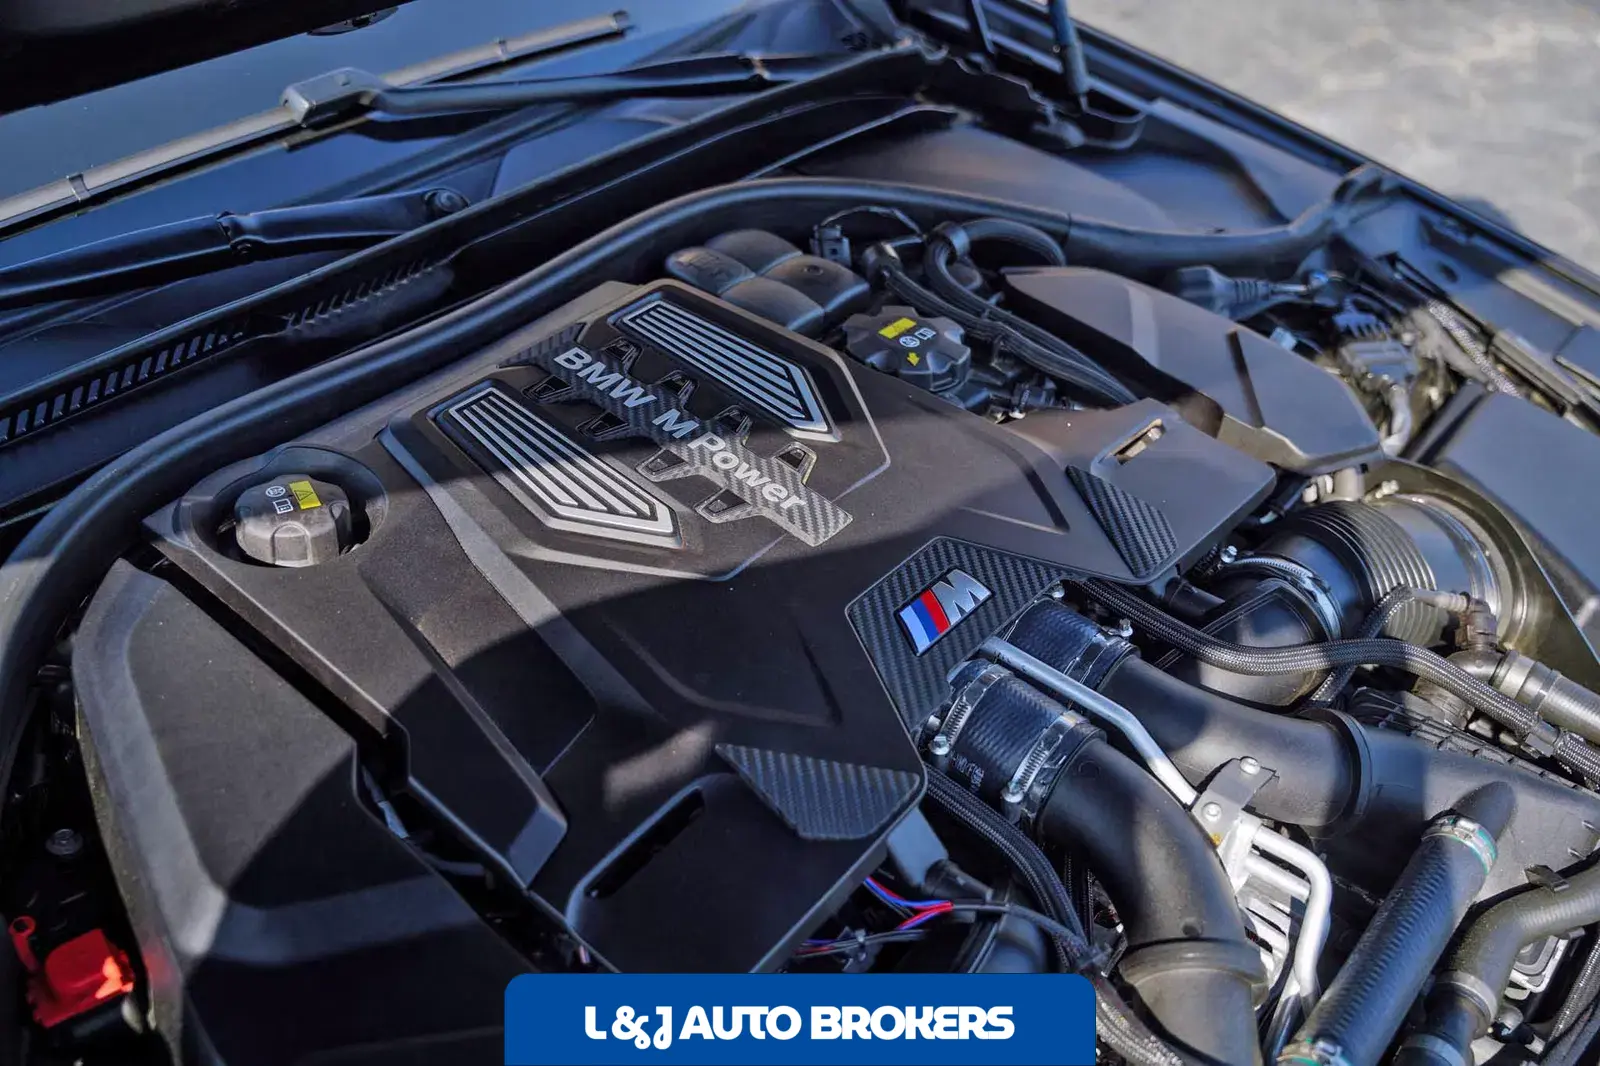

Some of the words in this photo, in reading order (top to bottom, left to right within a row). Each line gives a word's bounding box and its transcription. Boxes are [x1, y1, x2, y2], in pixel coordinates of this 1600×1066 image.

[552, 346, 657, 409] BMW
[652, 407, 699, 439] M
[688, 431, 809, 511] Power
